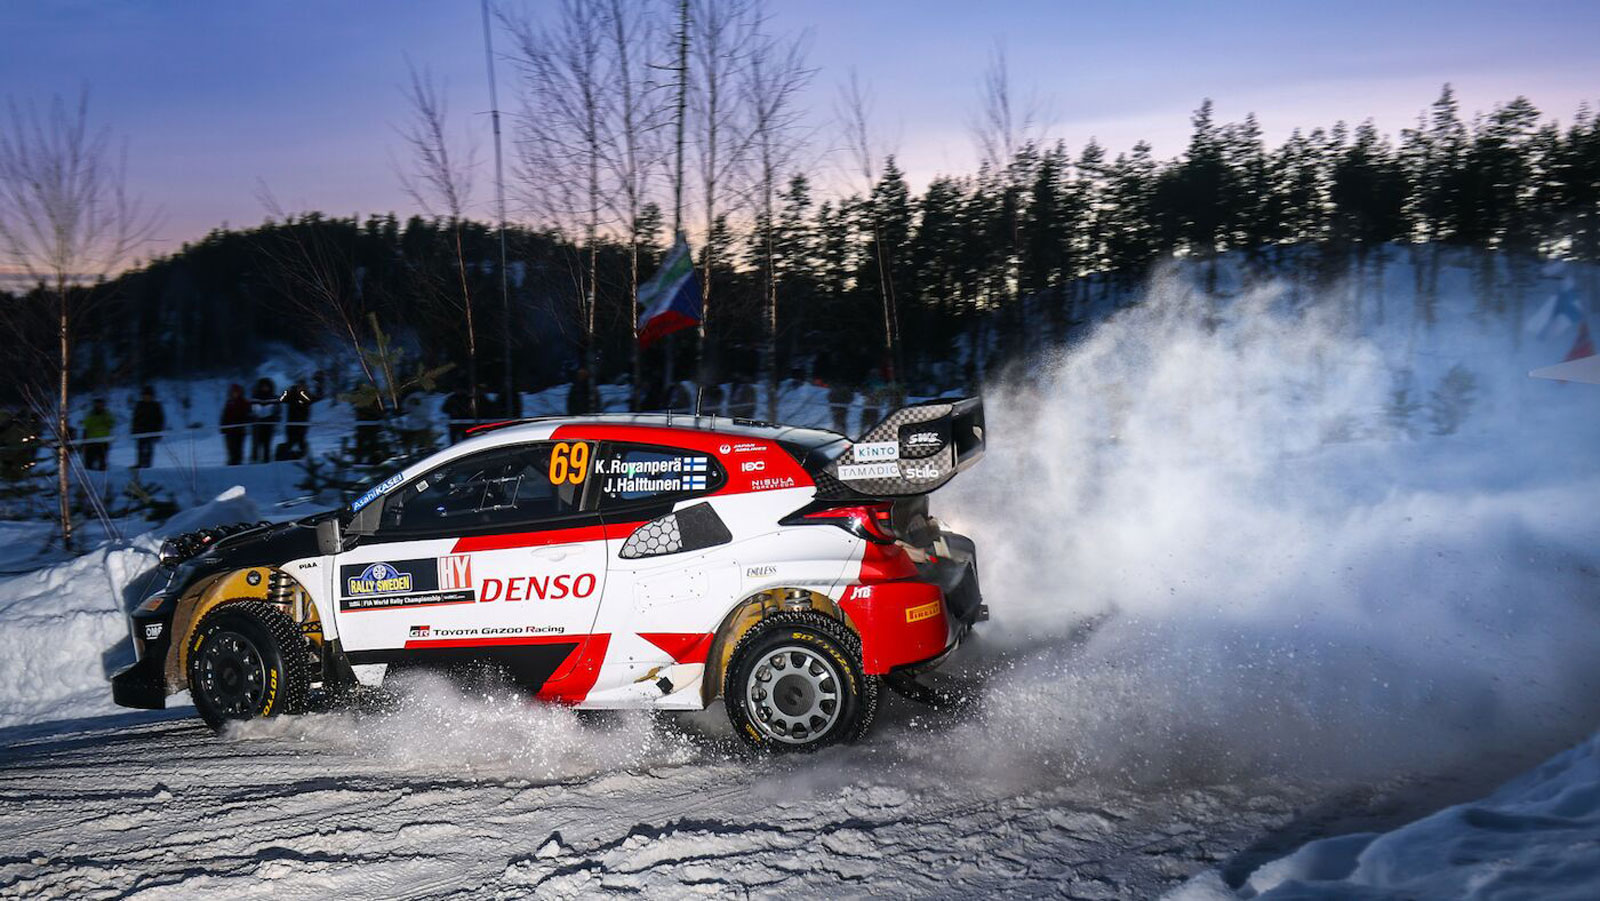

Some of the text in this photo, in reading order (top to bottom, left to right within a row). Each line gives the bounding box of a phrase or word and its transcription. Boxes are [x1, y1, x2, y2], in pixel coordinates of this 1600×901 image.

[549, 442, 589, 485] 69
[906, 463, 939, 479] Stilo
[842, 466, 899, 477] TAMADIC
[604, 478, 681, 493] J.Halttunen
[299, 562, 317, 570] PIAA
[440, 555, 471, 590] HY
[746, 566, 777, 577] ENDLESS
[350, 576, 410, 594] RALLY SWEDEN
[480, 573, 597, 602] DENSO
[364, 599, 373, 607] FIA
[374, 598, 389, 606] World
[390, 597, 403, 606] Rally
[404, 594, 441, 604] Championship
[850, 587, 871, 600] JTB
[910, 602, 939, 619] PIRELLI
[433, 625, 565, 637] TOYOTA GAZOO Racing
